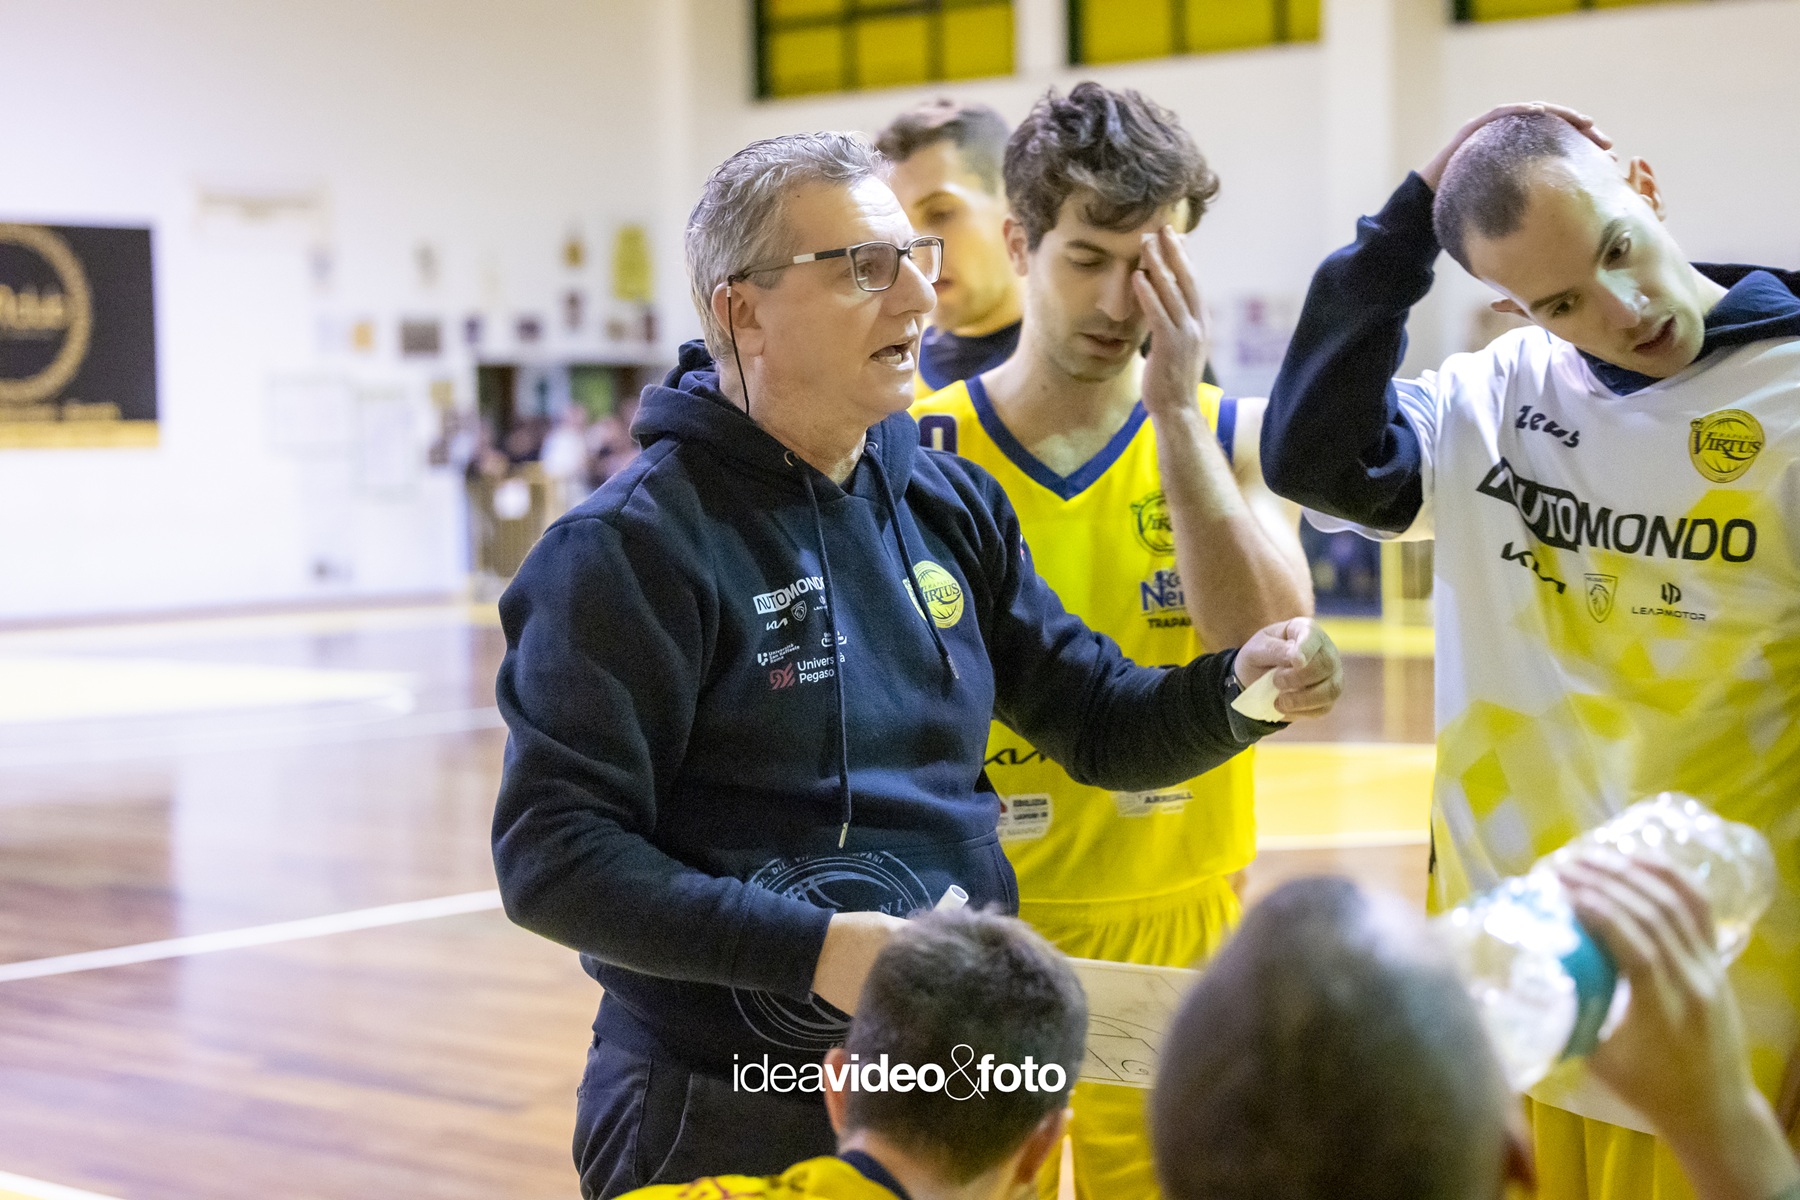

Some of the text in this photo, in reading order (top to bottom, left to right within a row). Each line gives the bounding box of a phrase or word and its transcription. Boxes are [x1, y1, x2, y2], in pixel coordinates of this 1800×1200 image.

[1692, 430, 1763, 461] VIRTUS
[1477, 457, 1758, 563] AUTOMONDO
[1631, 606, 1707, 622] LEAPMOTOR
[798, 668, 835, 684] Pegaso
